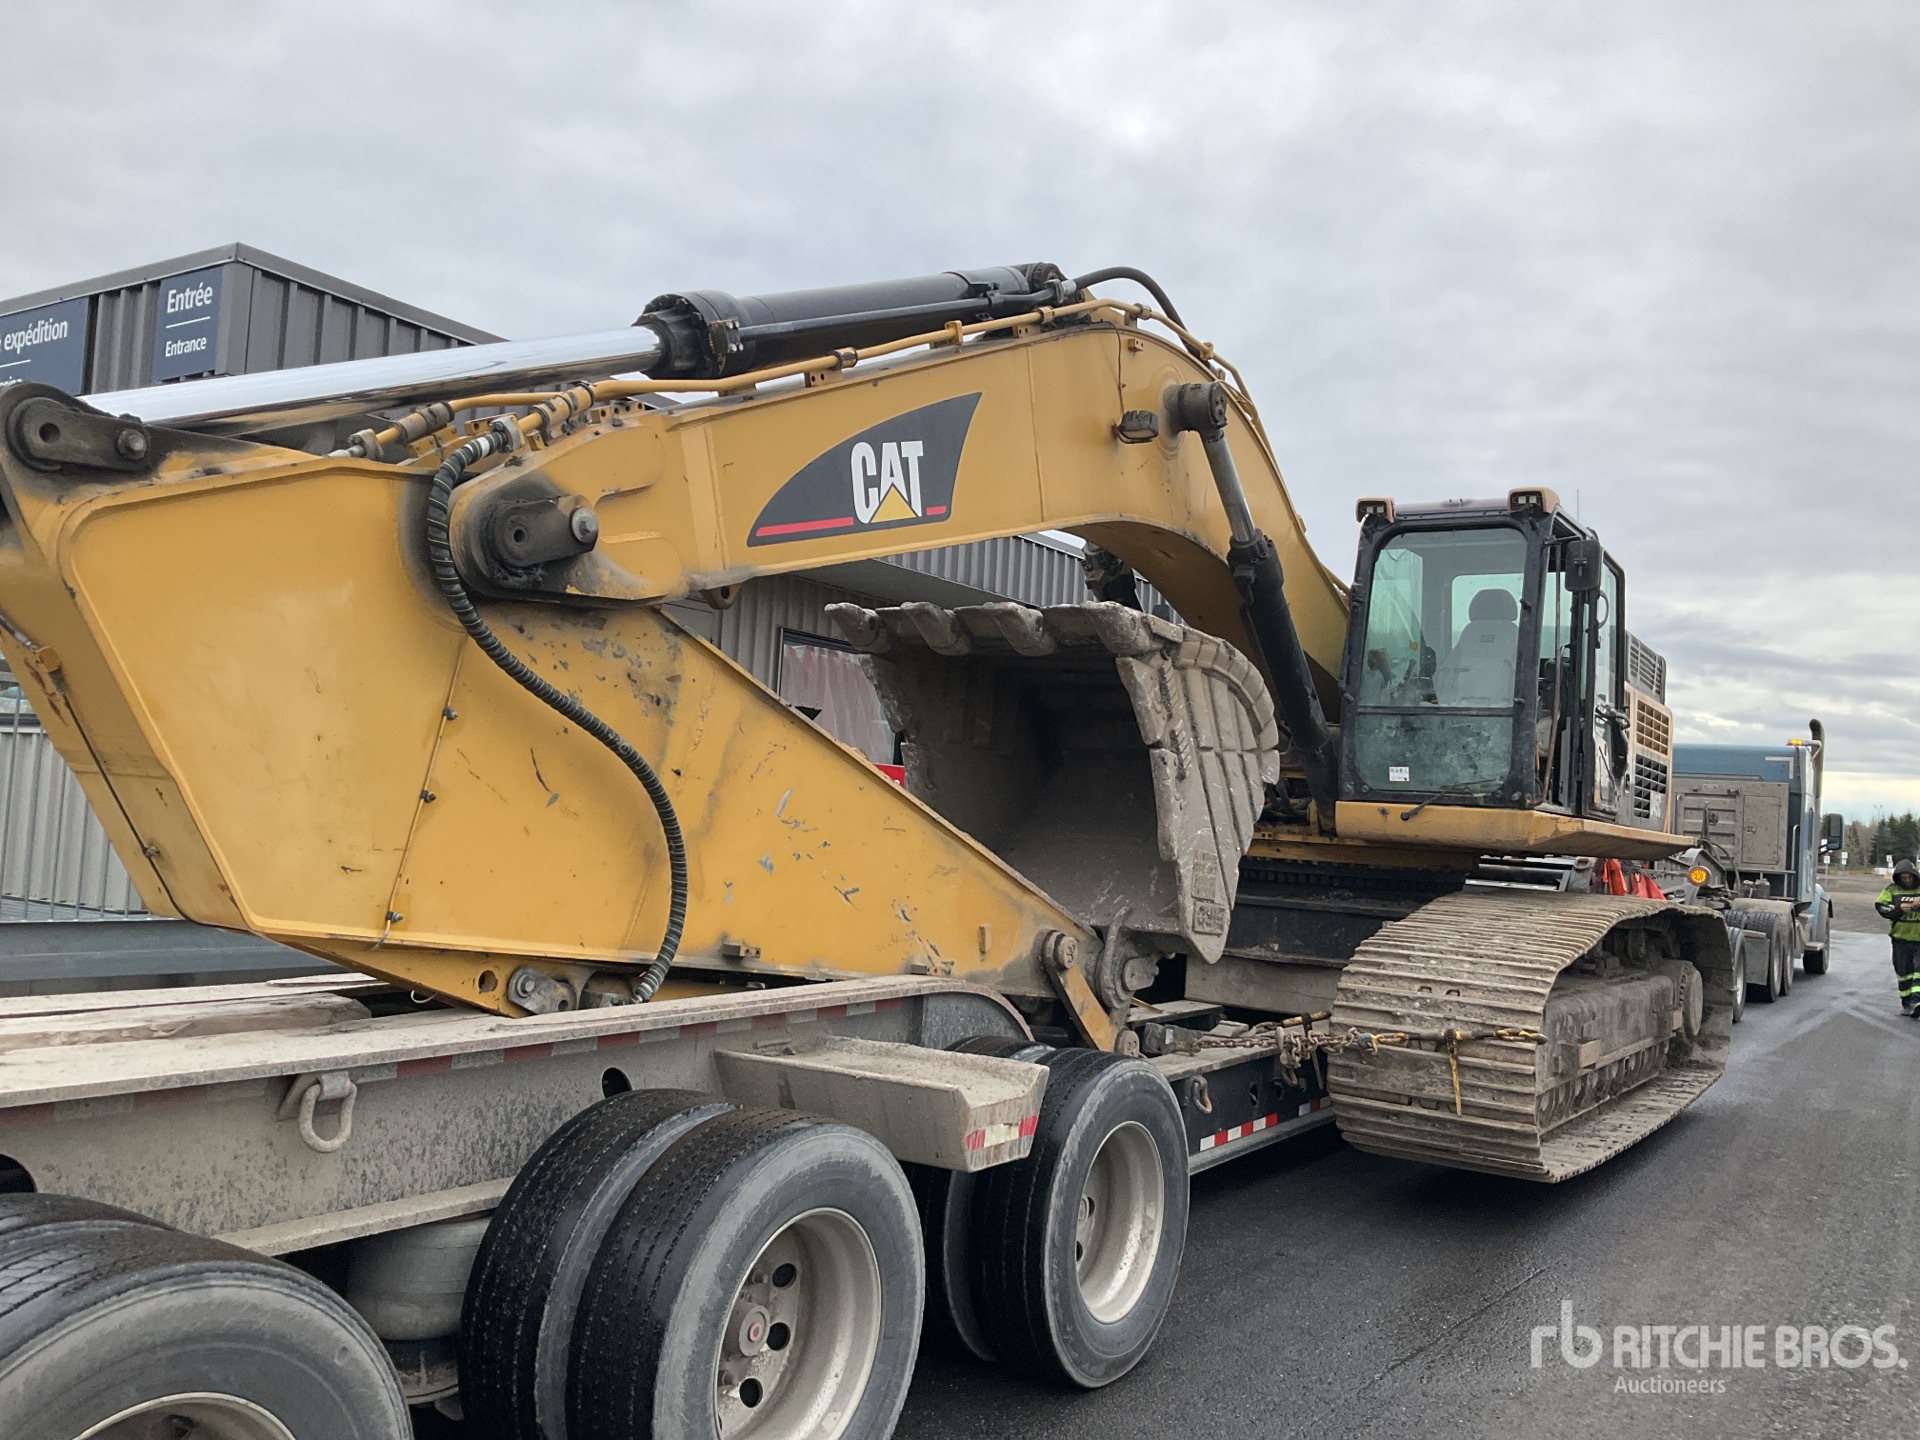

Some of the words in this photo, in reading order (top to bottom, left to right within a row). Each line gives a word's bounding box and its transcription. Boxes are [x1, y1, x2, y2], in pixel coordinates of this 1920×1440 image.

[167, 282, 213, 313] Entrée
[4, 317, 68, 354] expédition
[165, 337, 207, 357] Entrance
[851, 440, 924, 524] CAT
